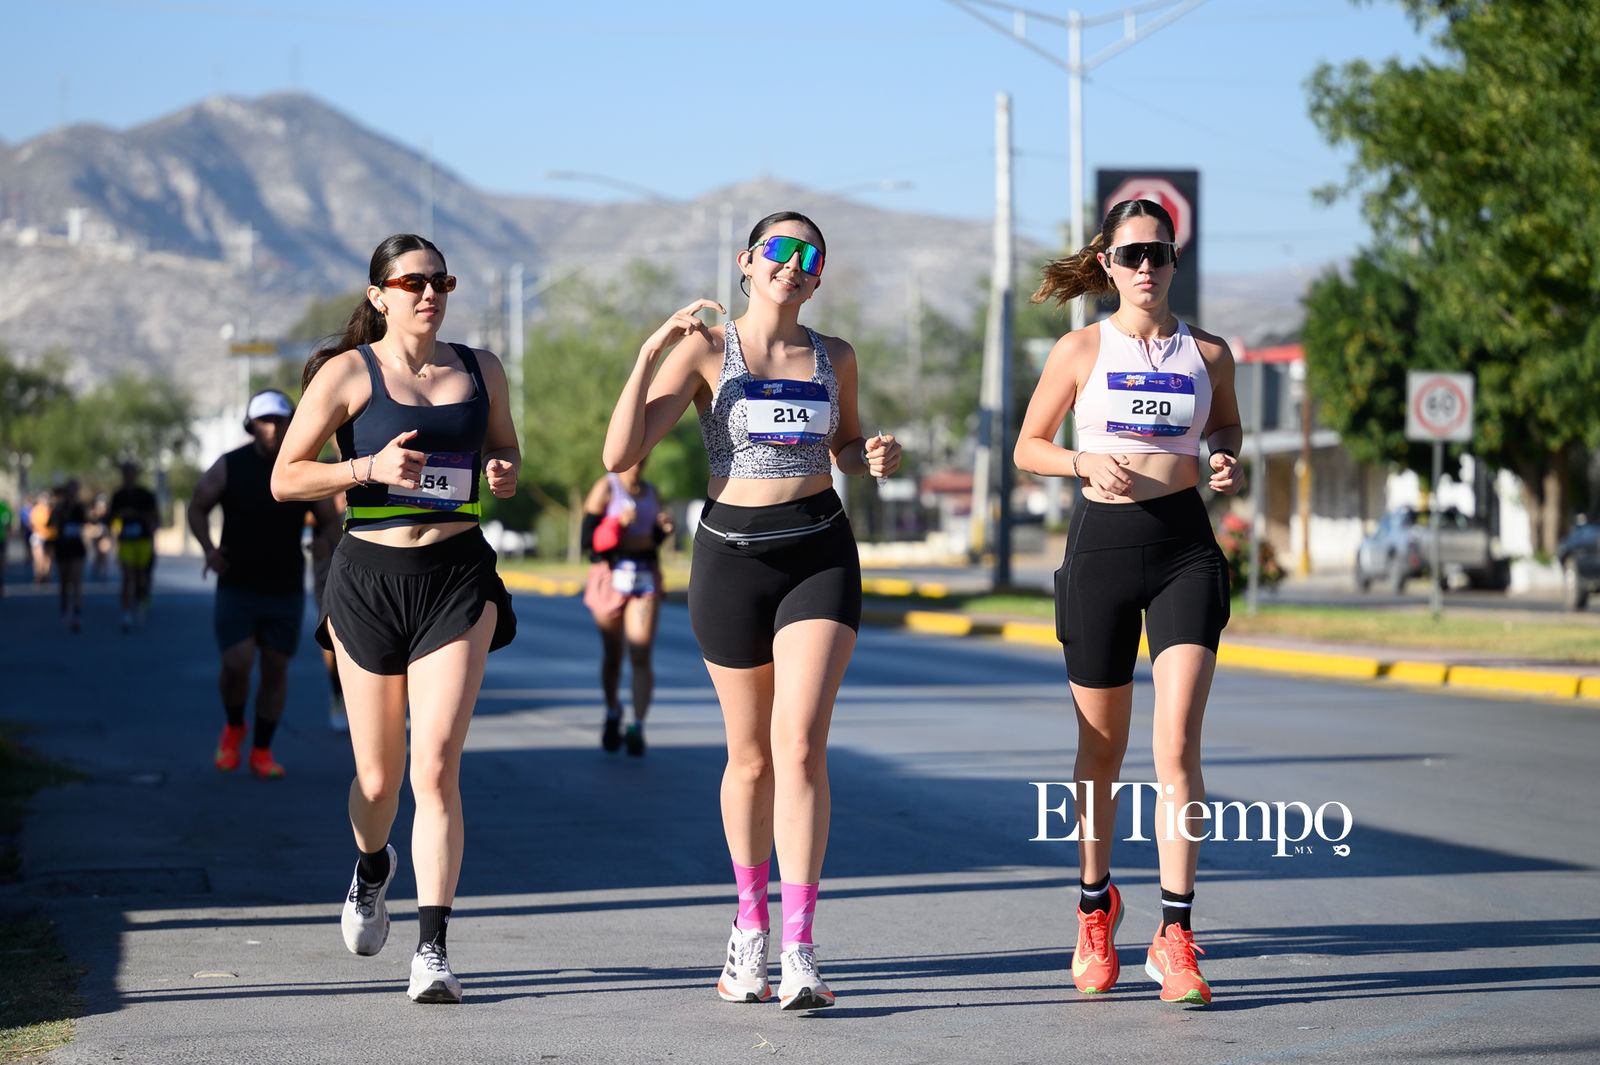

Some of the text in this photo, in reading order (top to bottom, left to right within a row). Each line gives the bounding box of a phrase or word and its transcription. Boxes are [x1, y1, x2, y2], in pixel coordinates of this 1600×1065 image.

[1131, 399, 1172, 416] 220
[1425, 391, 1457, 416] 60
[773, 408, 810, 423] 214
[419, 475, 449, 490] 54
